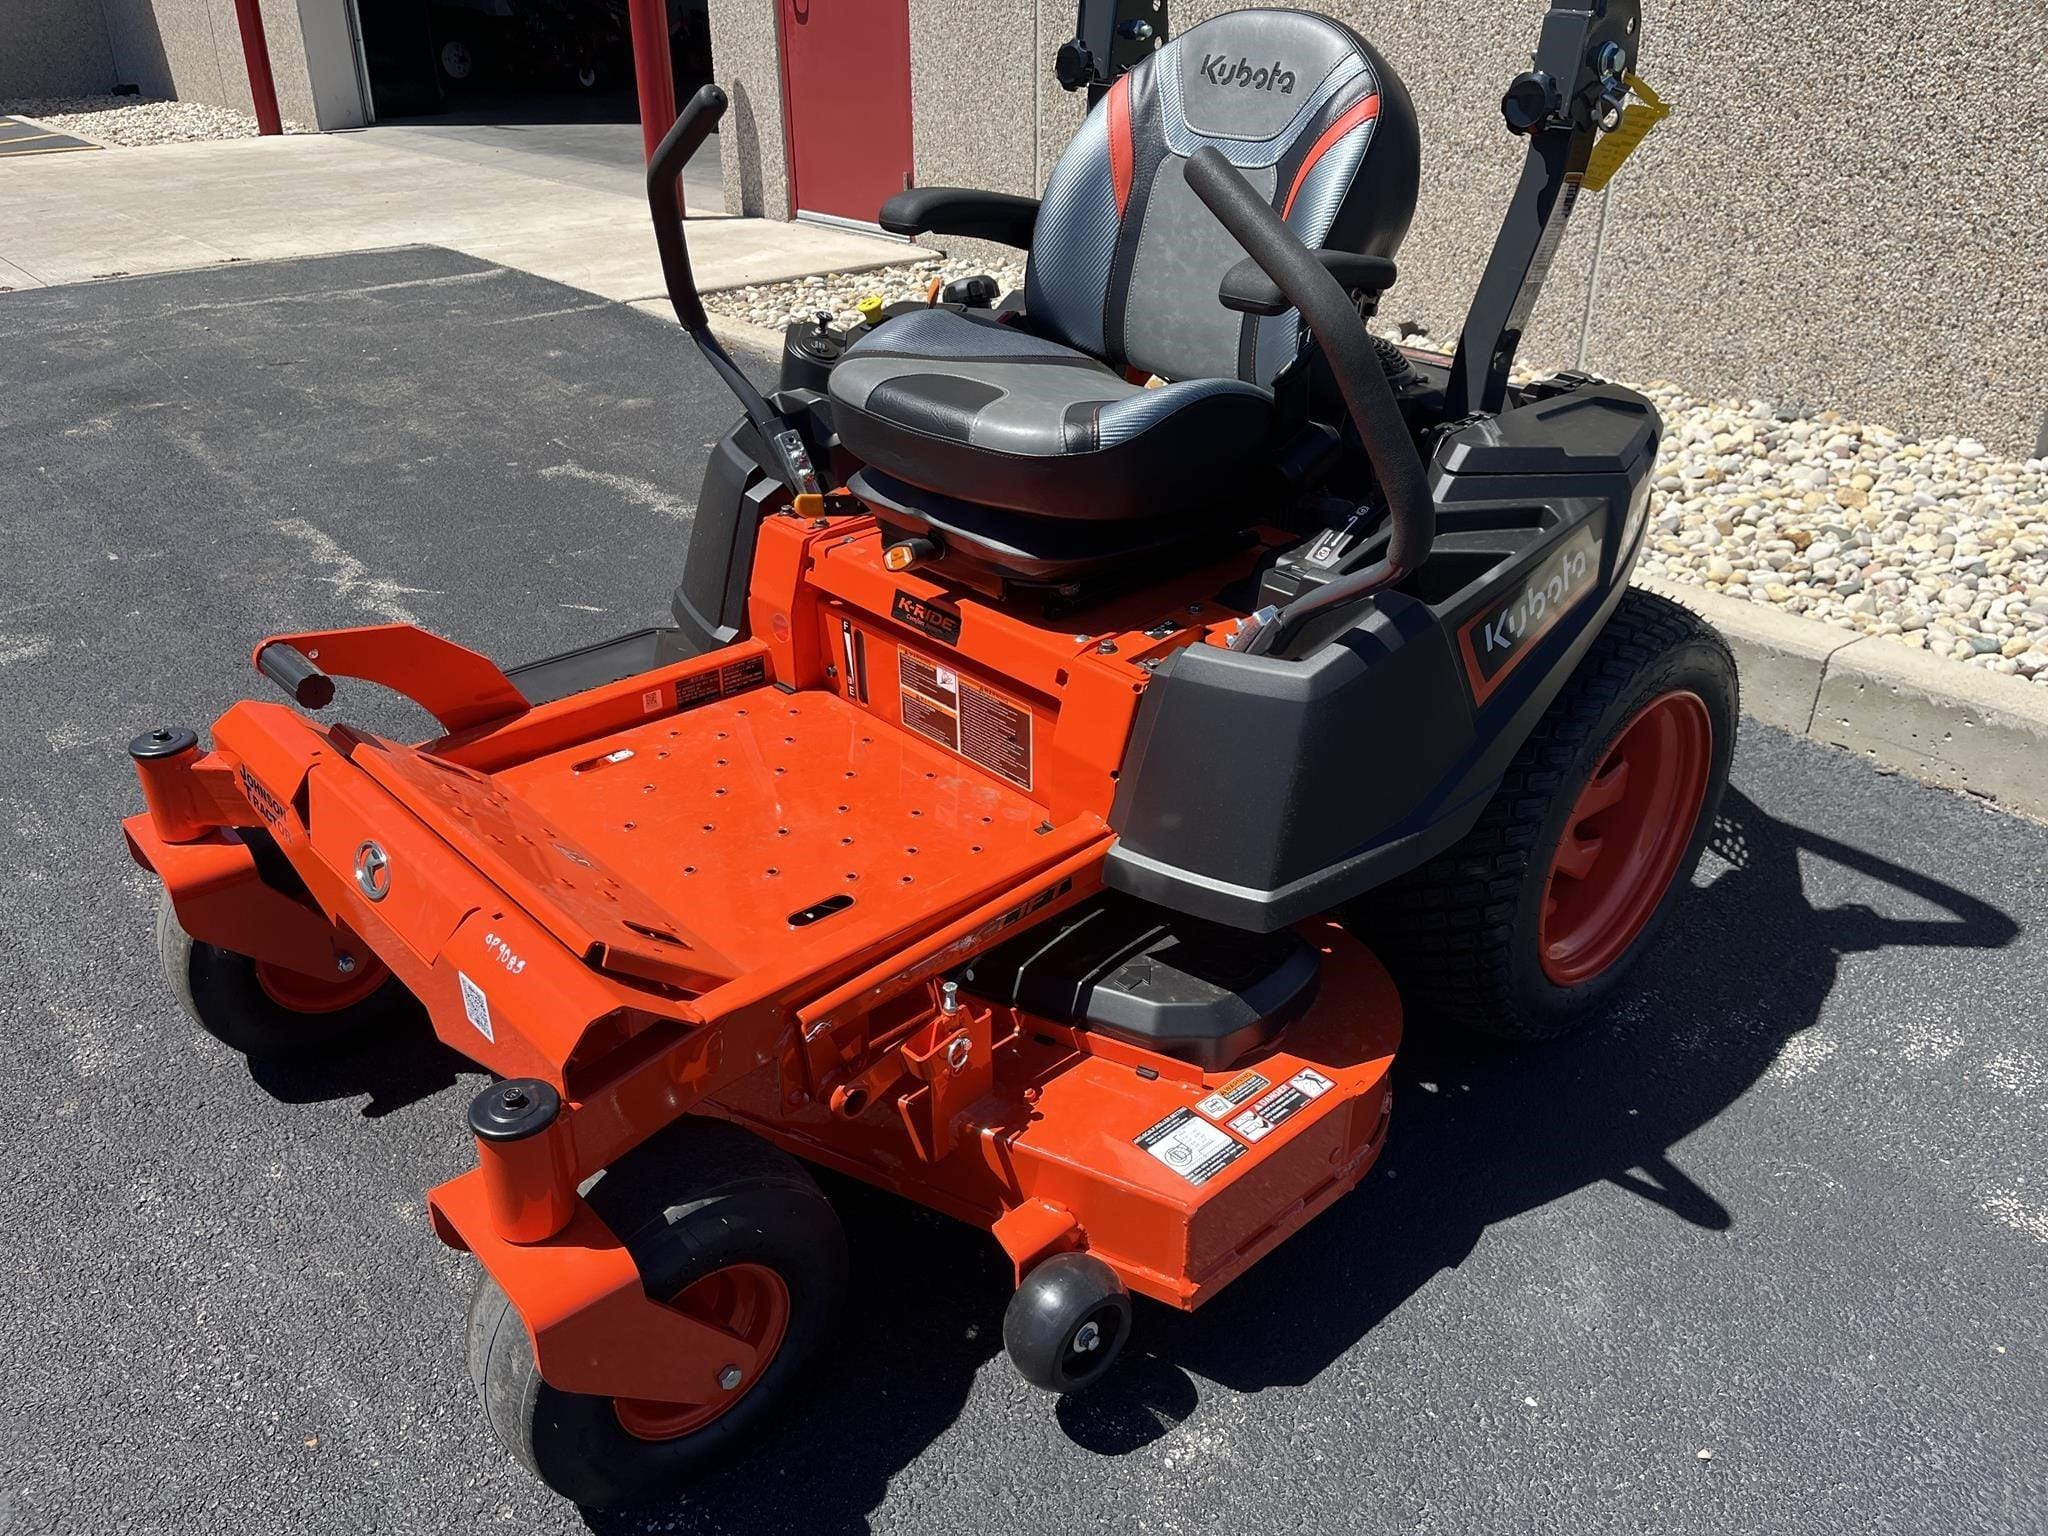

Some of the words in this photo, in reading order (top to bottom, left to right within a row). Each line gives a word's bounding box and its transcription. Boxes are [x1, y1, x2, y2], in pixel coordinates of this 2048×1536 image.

[1200, 54, 1296, 94] Kubota
[898, 597, 957, 632] K-RIDE
[1484, 551, 1586, 653] Kubota
[843, 621, 849, 631] F
[849, 685, 855, 696] E
[240, 763, 287, 822] JOHNSON
[243, 781, 292, 844] TRACTOR
[1258, 1083, 1290, 1107] DANGER
